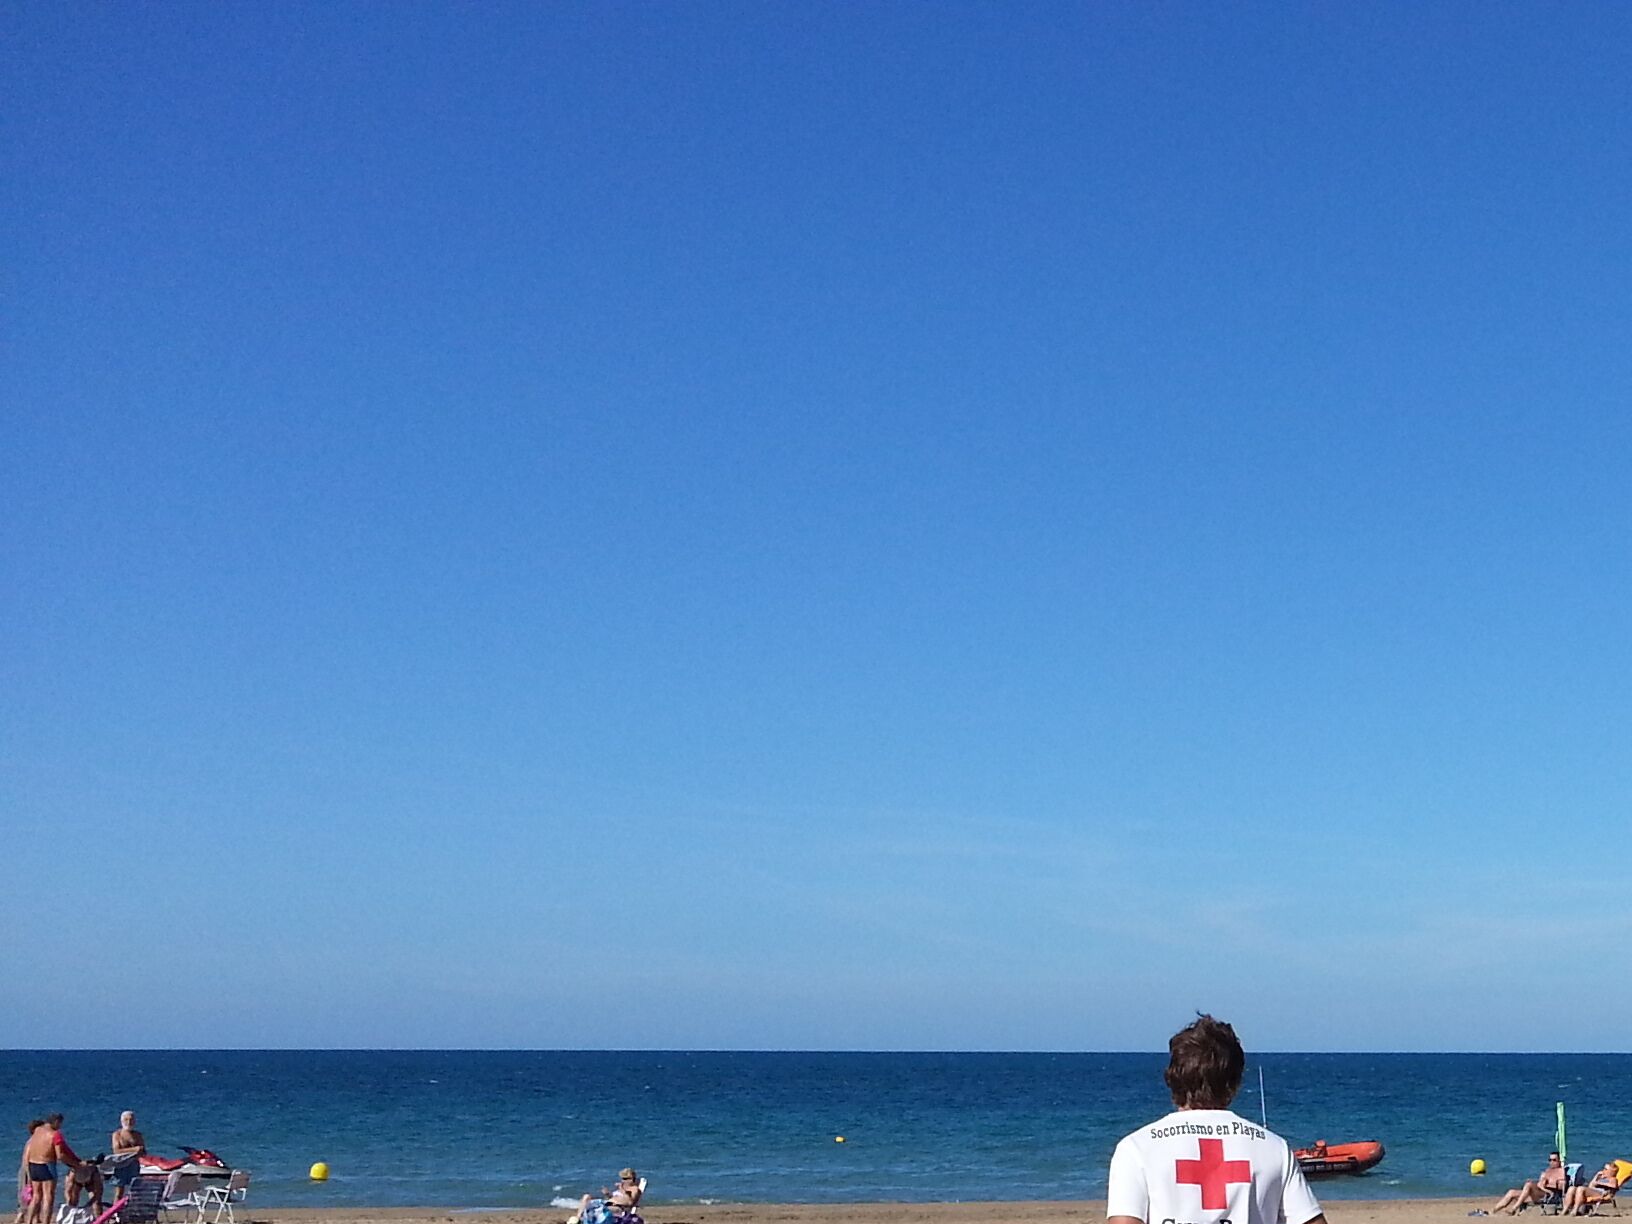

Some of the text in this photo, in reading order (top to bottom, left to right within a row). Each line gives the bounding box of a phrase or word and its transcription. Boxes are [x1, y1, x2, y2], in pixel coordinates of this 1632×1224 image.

[1150, 1121, 1266, 1140] Socorrismo en Playas
